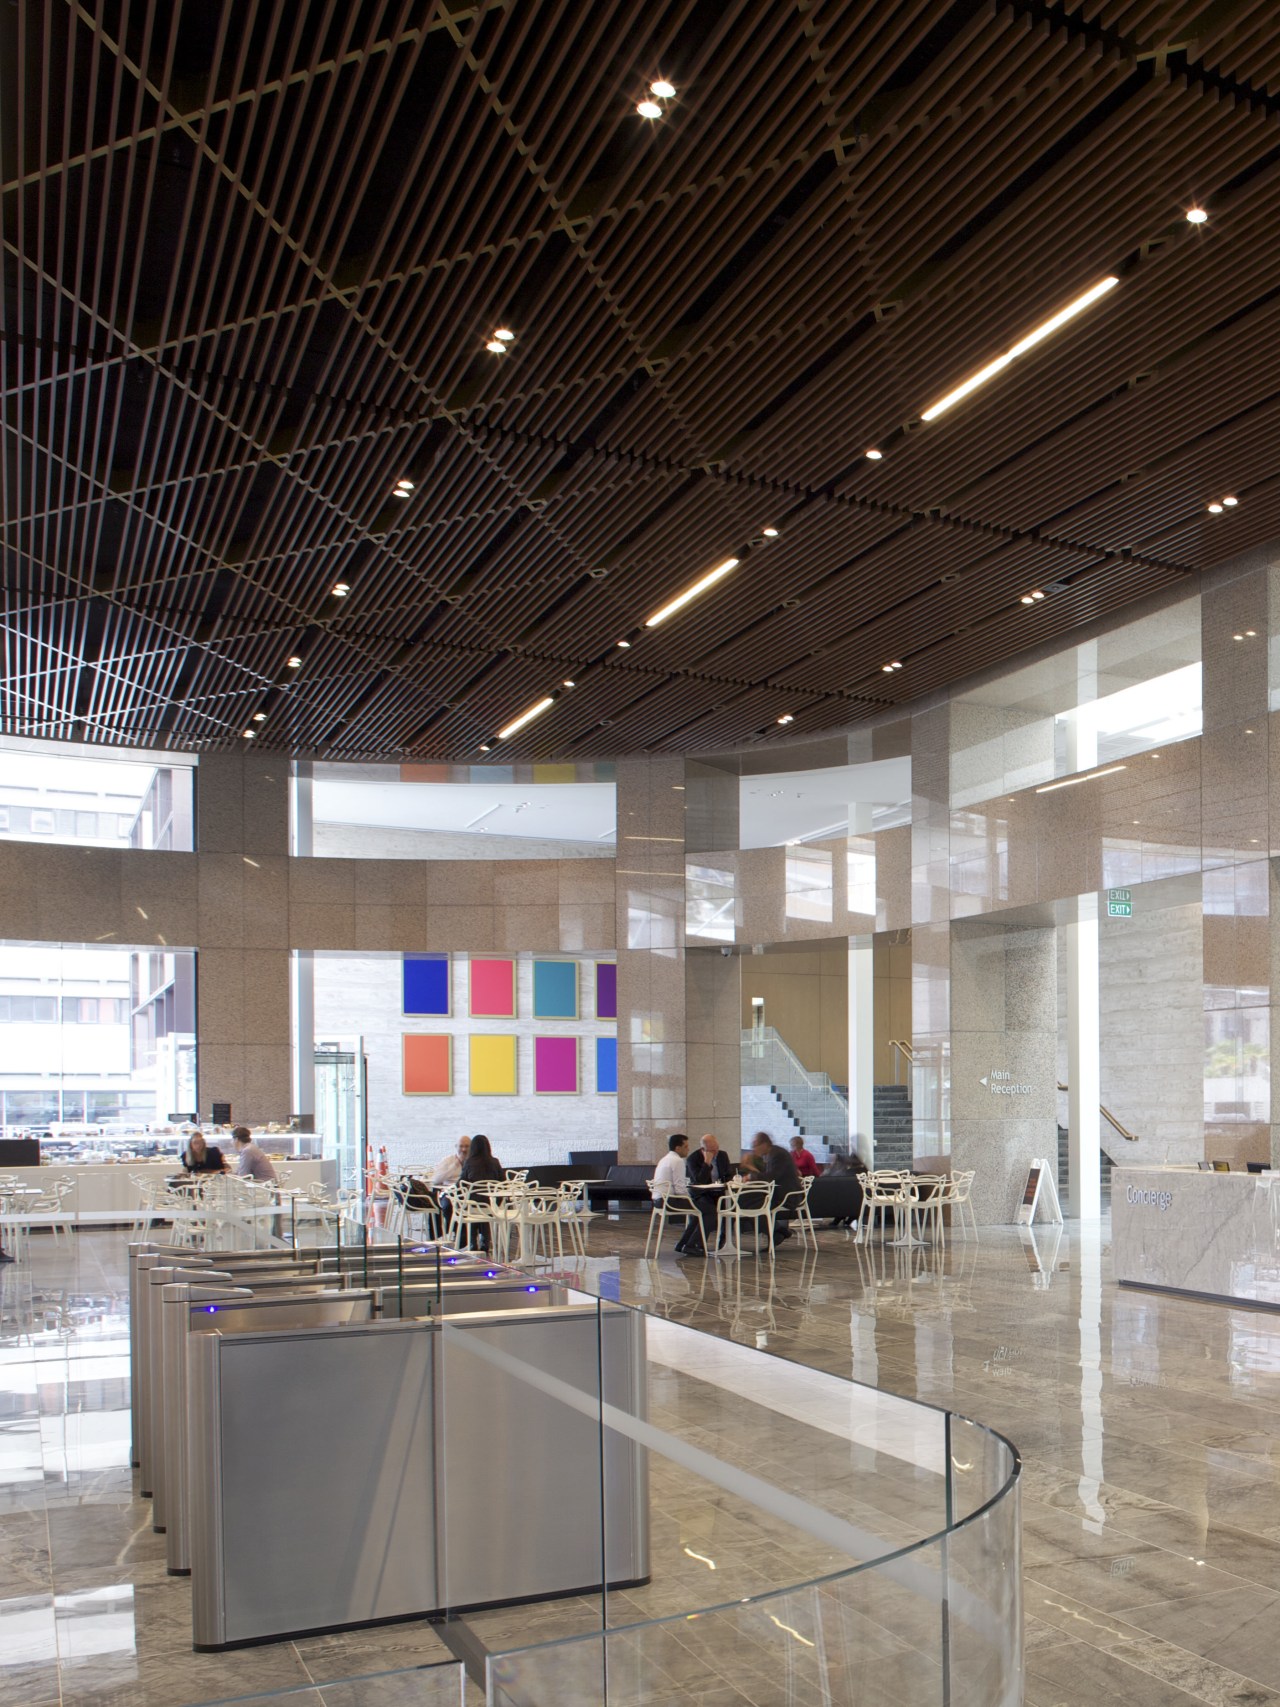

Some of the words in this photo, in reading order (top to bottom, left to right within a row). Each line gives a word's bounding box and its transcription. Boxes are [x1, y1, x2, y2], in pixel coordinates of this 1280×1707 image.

[1110, 904, 1126, 915] EXIT
[991, 1070, 1011, 1081] Main
[991, 1083, 1033, 1097] Reception
[1126, 1184, 1172, 1211] Concierge
